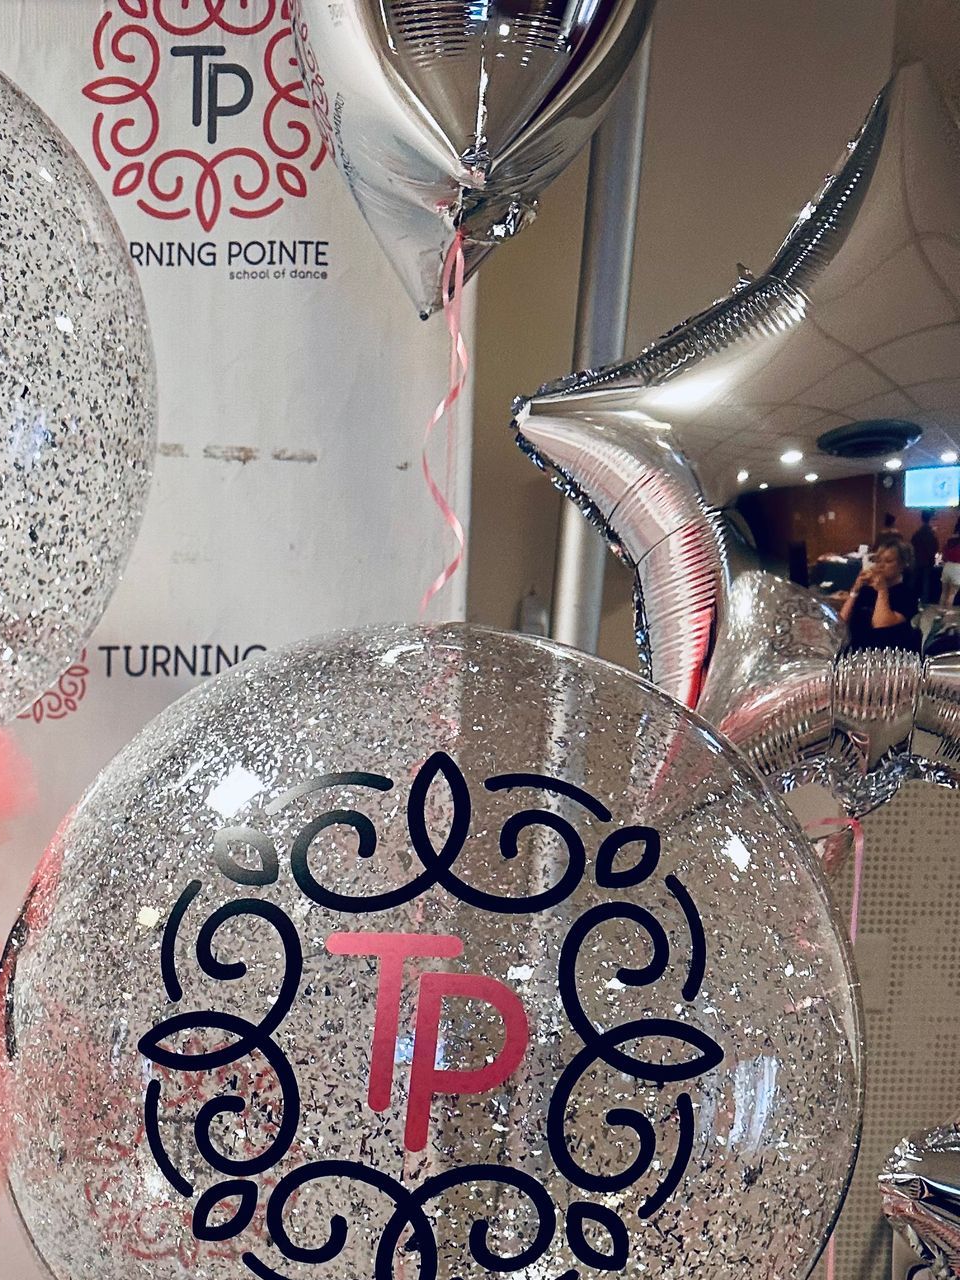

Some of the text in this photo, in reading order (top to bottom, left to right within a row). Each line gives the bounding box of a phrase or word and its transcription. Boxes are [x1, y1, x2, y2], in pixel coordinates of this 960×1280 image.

[228, 240, 329, 266] POINTE
[229, 267, 328, 281] school of dance
